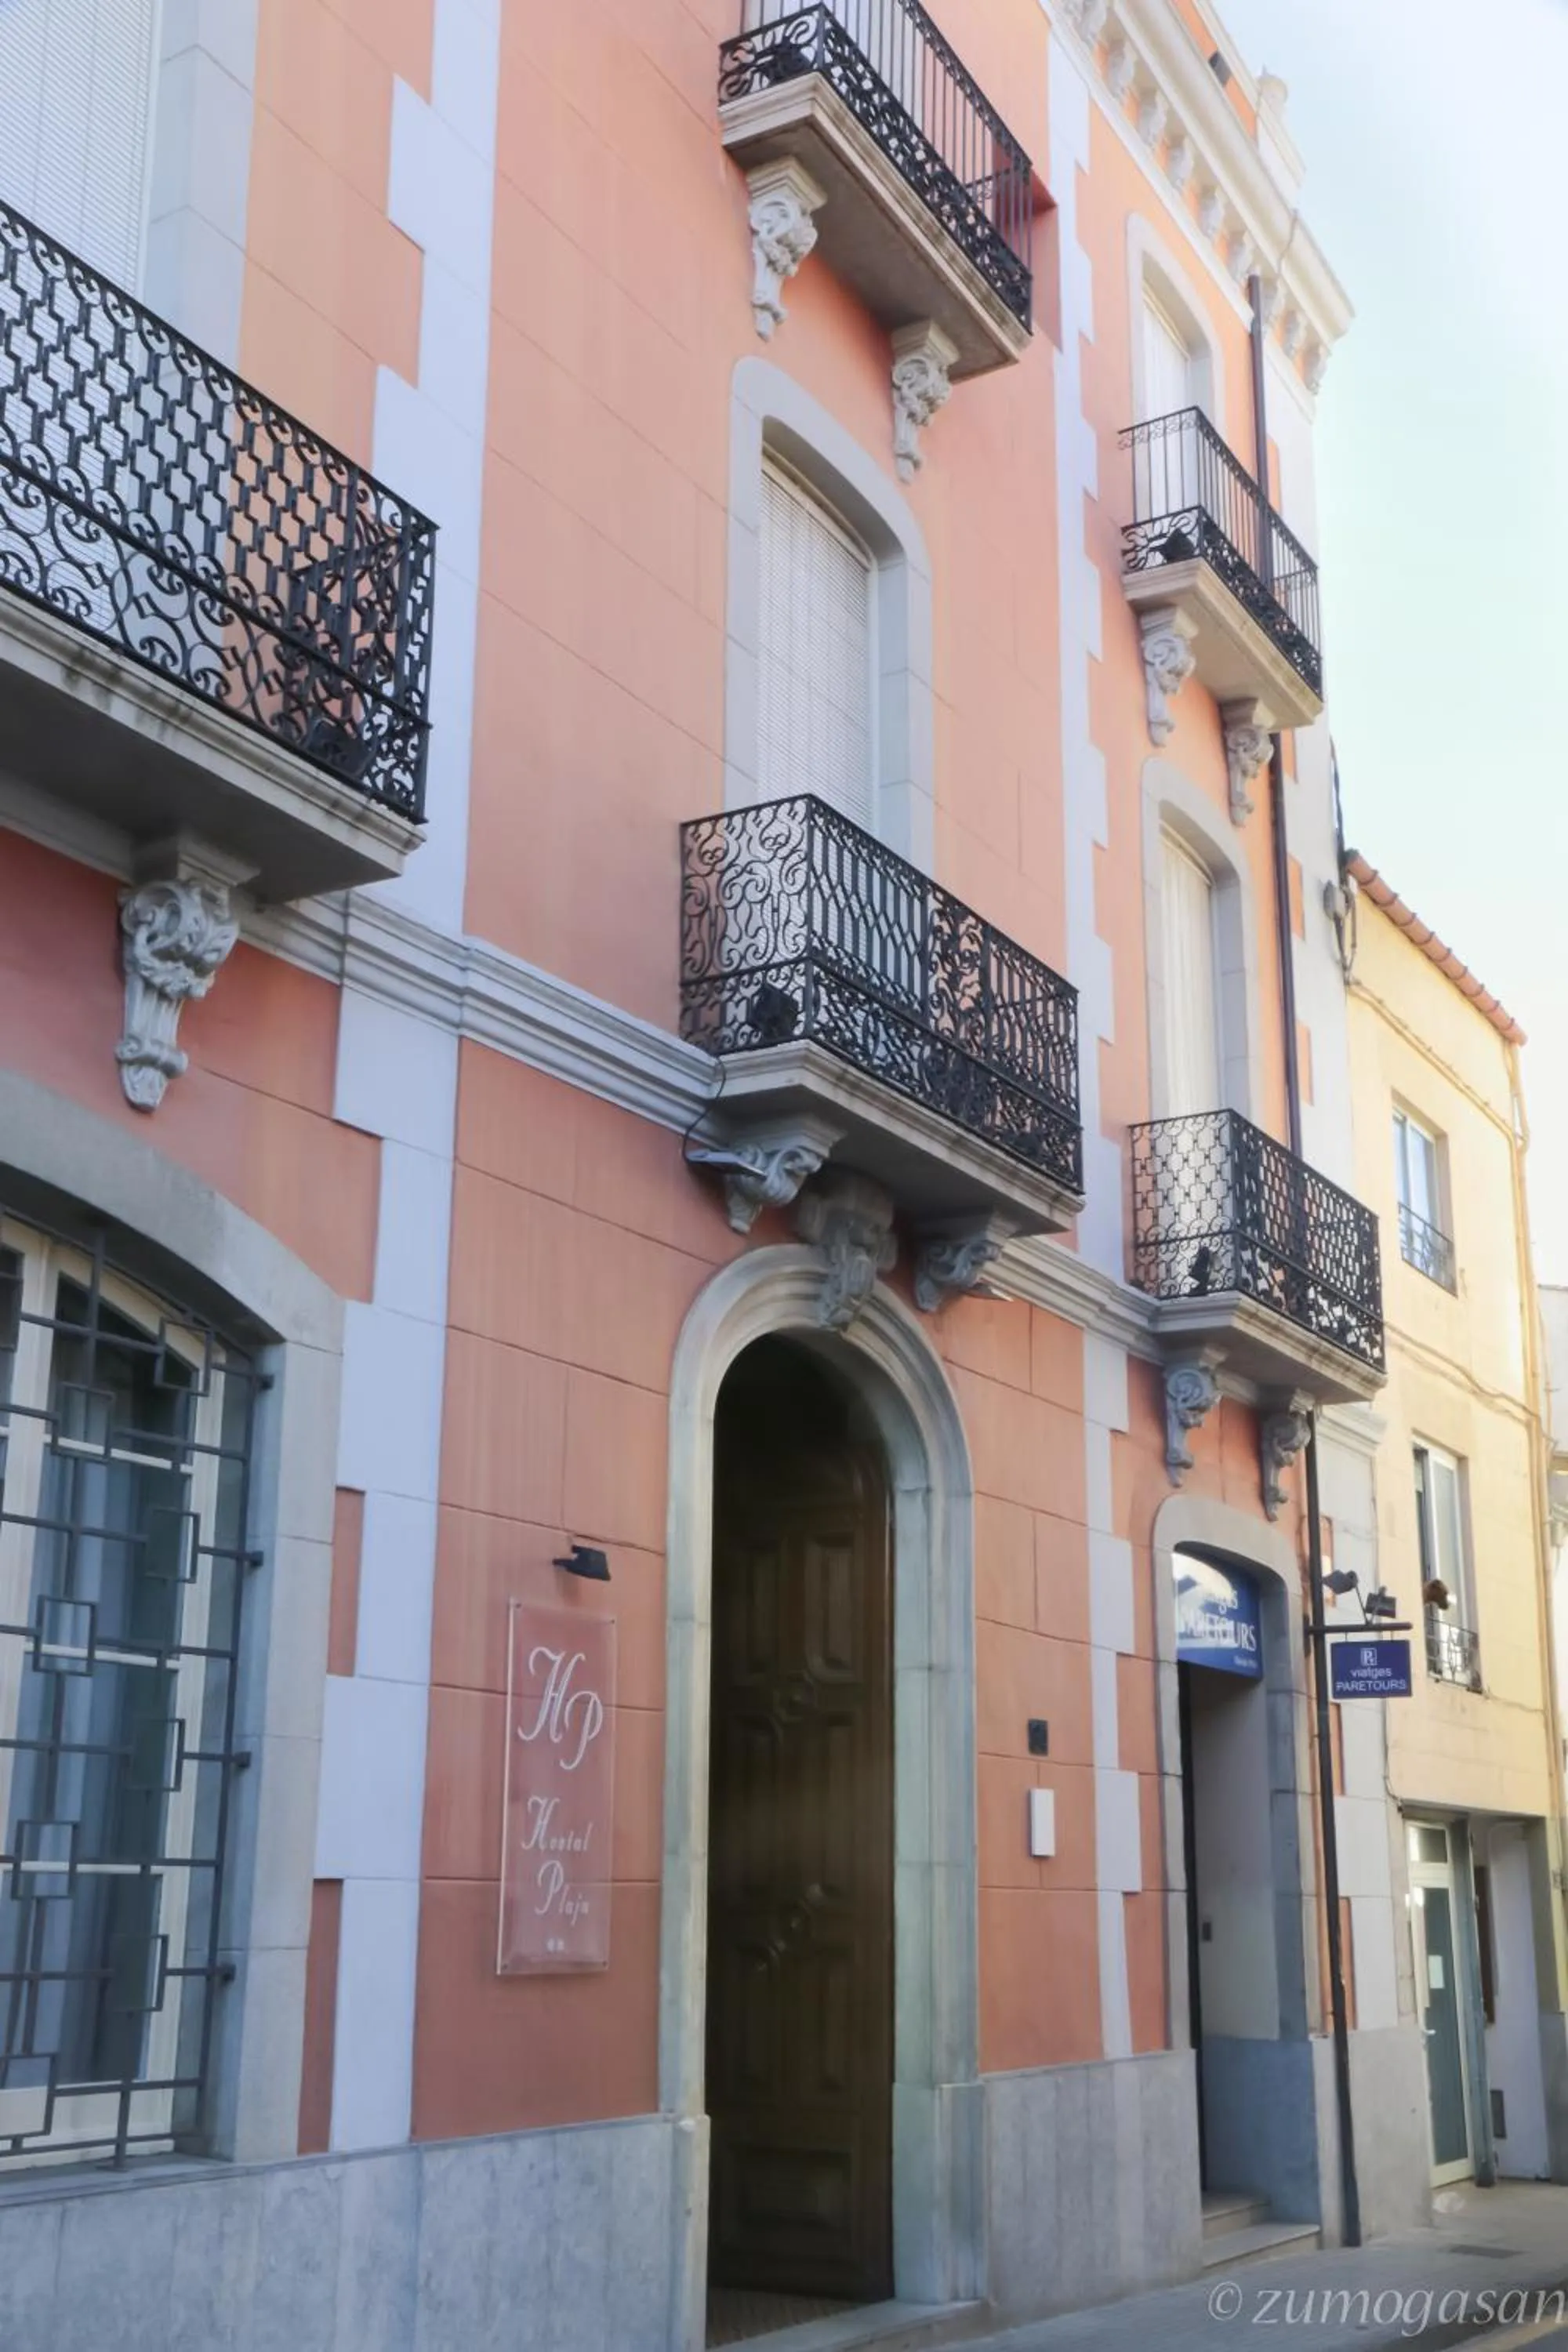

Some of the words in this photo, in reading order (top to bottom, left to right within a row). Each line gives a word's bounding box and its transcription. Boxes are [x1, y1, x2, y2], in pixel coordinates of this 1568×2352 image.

[1335, 1679, 1406, 1691] PARETOURS
[1350, 1667, 1392, 1679] viatges
[521, 1795, 593, 1851] Hostal
[535, 1860, 590, 1927] Plaja
